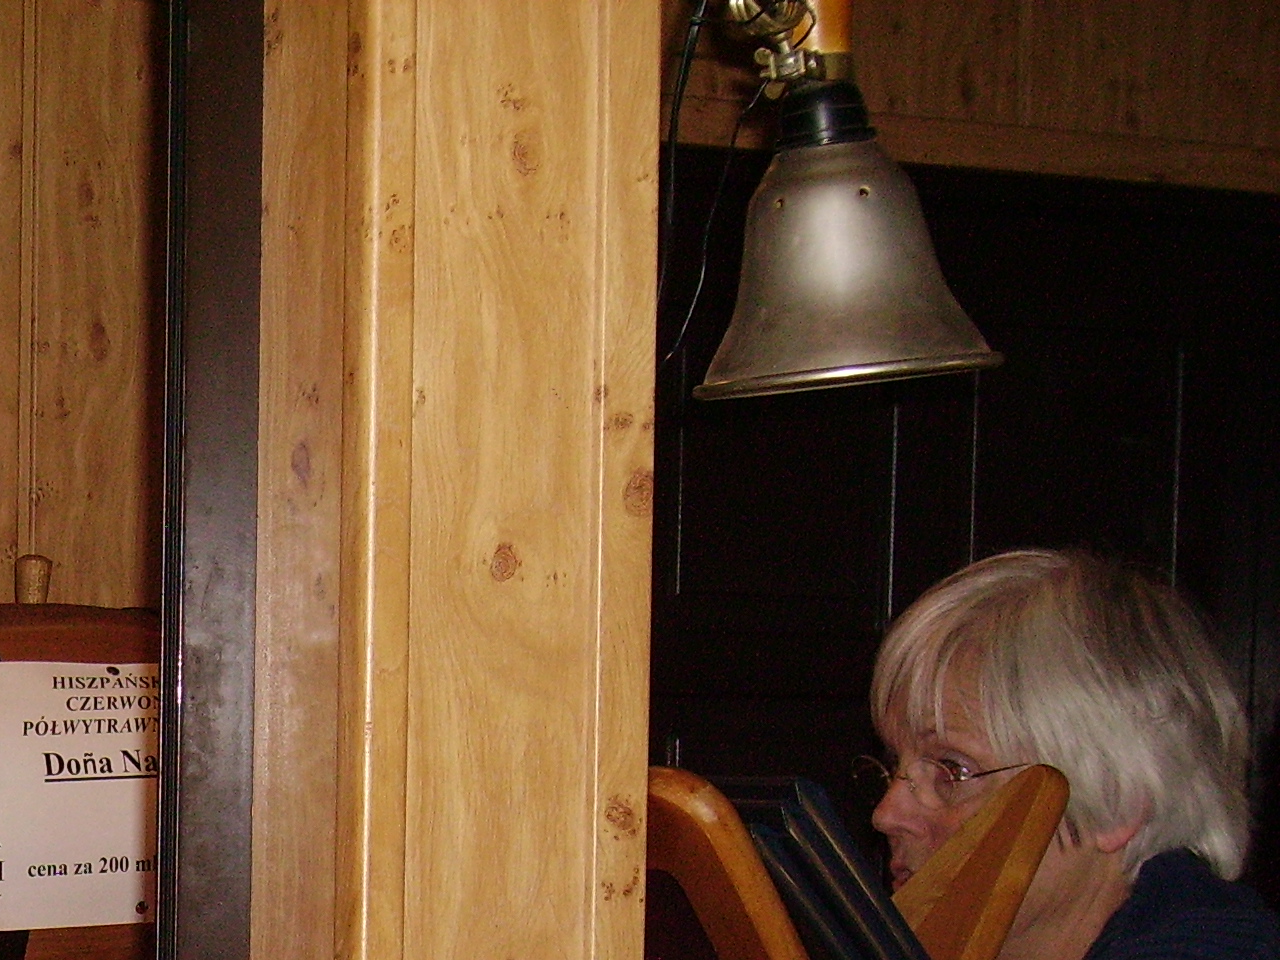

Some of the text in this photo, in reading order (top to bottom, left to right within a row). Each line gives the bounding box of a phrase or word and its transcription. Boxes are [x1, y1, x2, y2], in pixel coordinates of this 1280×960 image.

[42, 751, 114, 777] Doña
[27, 862, 68, 878] cena
[73, 862, 93, 876] za
[98, 855, 129, 874] 200
